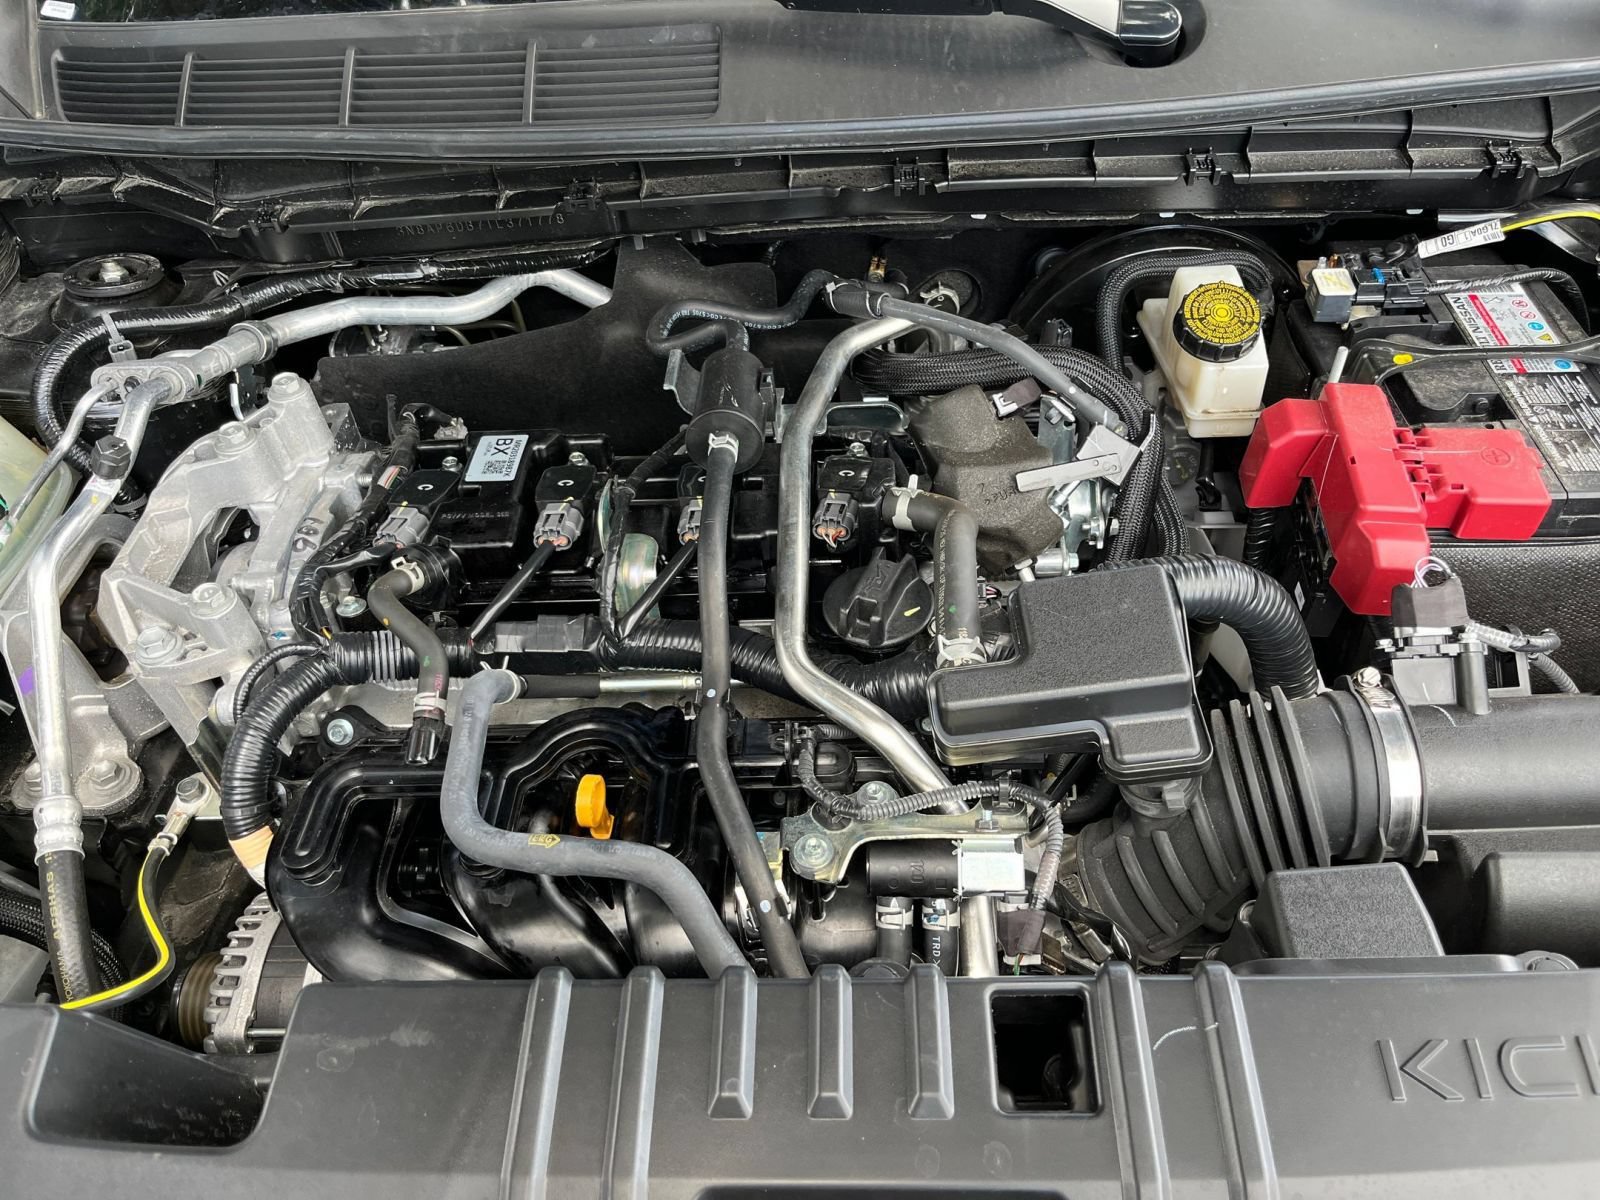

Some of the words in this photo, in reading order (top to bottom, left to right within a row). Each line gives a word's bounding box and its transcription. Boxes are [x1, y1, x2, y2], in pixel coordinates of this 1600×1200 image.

[1450, 296, 1484, 334] NISSAN
[491, 438, 514, 456] BX
[417, 483, 434, 491] C
[557, 479, 575, 487] C
[56, 949, 74, 1003] YOKOHAMA
[1376, 1035, 1600, 1102] KIC
